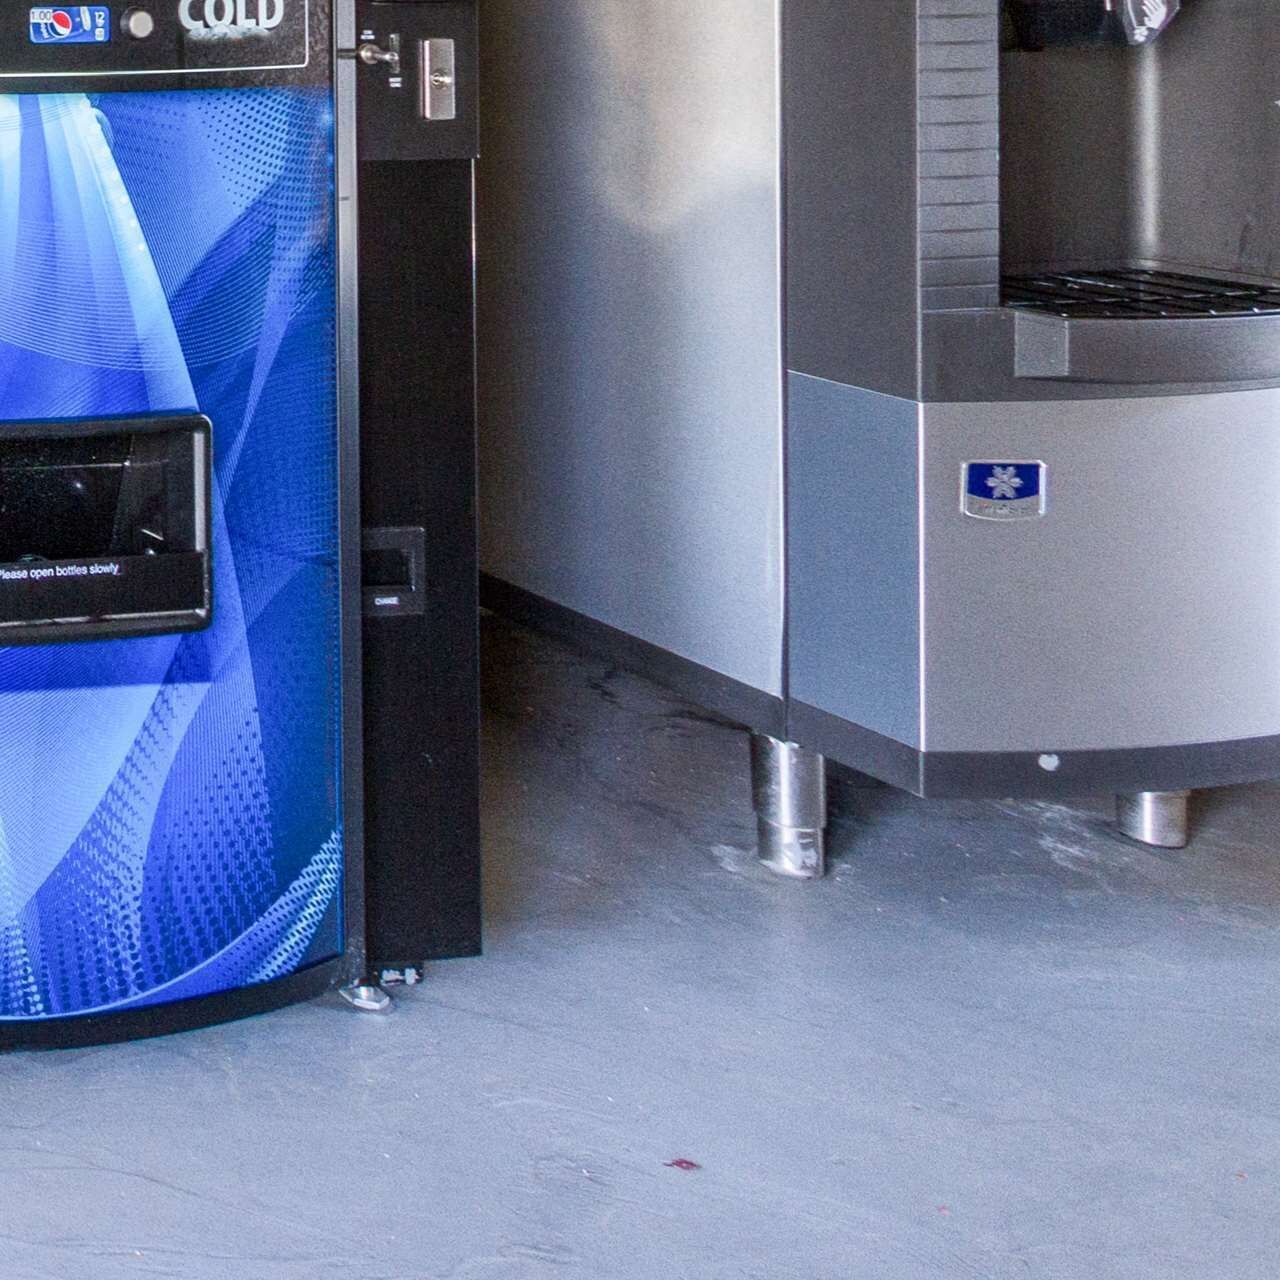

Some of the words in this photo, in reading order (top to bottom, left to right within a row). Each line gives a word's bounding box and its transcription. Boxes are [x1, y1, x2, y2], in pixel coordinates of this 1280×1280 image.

[30, 567, 54, 580] open
[55, 564, 88, 577] bottles
[89, 562, 120, 576] slowly
